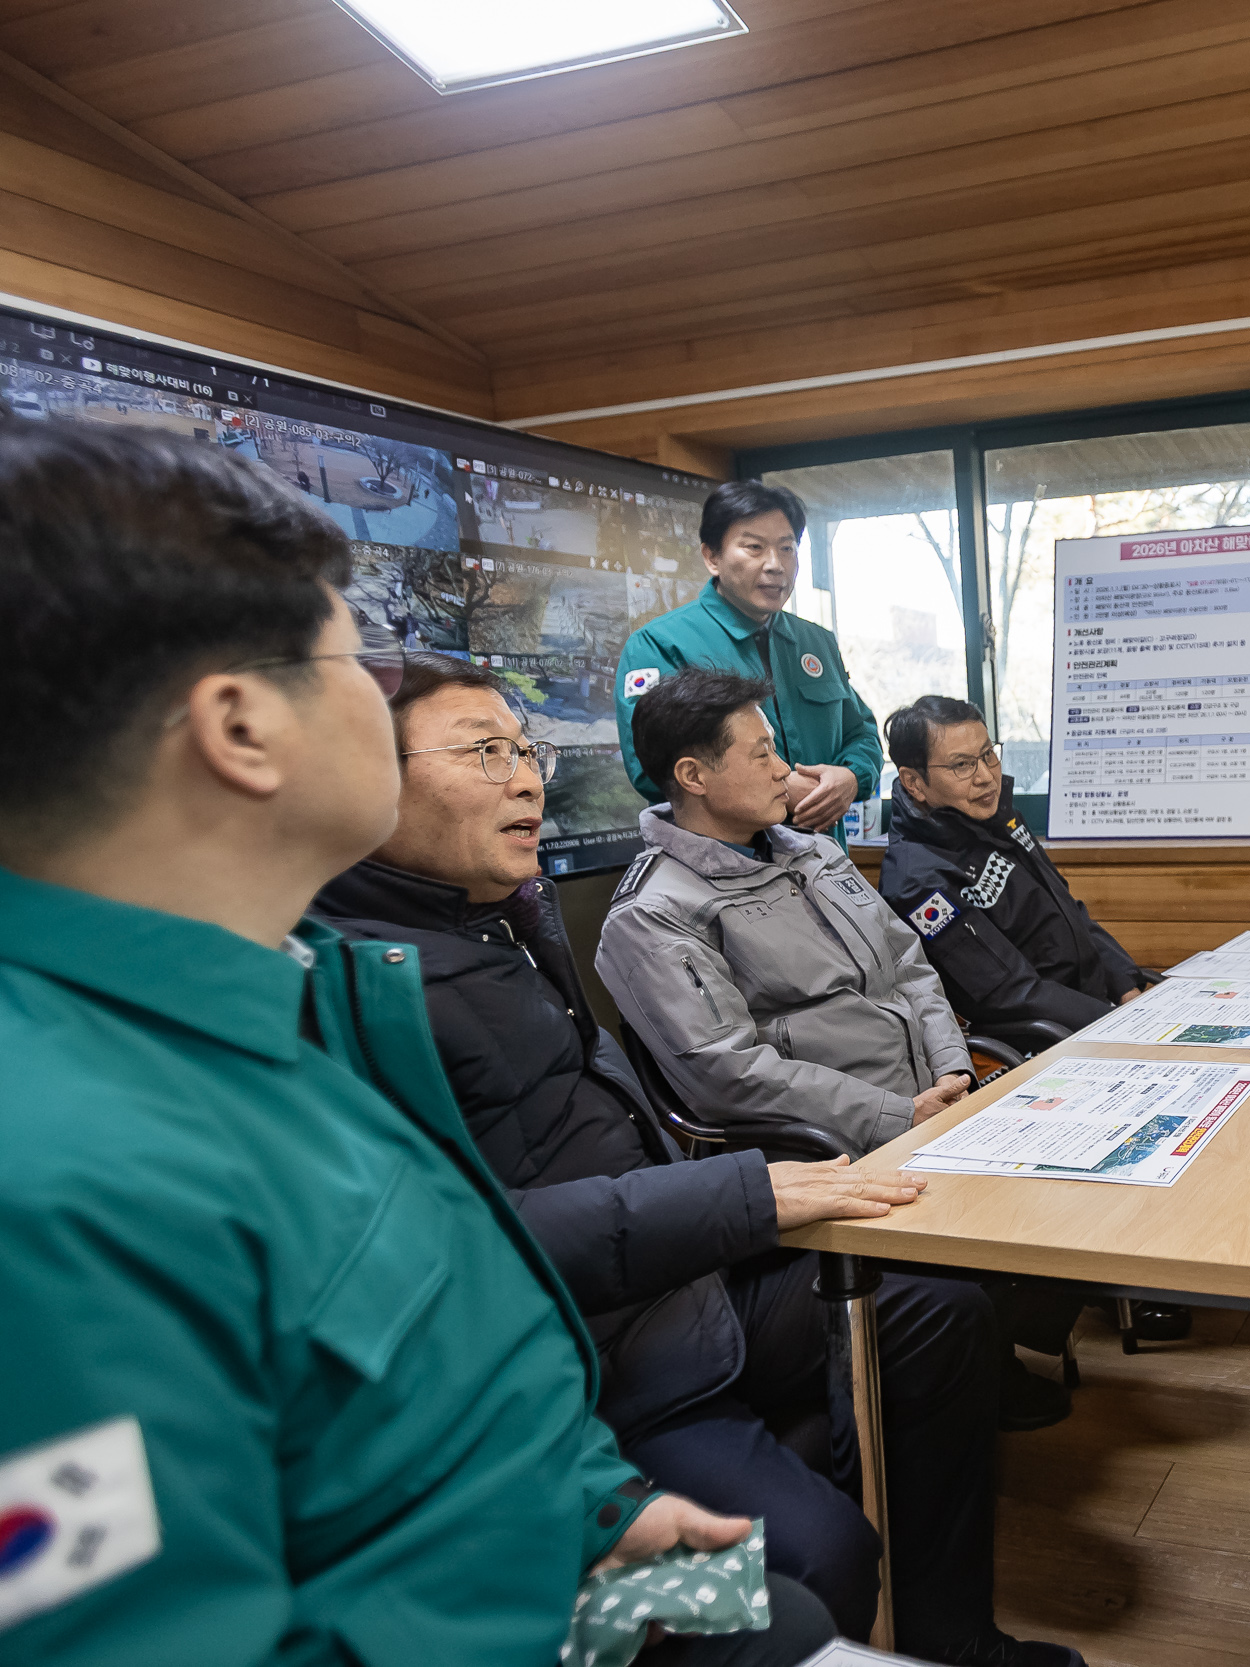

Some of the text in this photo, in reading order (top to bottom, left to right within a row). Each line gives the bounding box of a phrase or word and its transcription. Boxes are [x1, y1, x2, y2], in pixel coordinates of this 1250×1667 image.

[106, 363, 213, 397] 해맞이행사대비 (16)
[245, 415, 361, 447] [2] 공원-085-03-구의2
[1132, 542, 1177, 557] 2026년
[1180, 538, 1219, 554] 아차산
[1074, 628, 1104, 637] 개선사항
[1073, 660, 1118, 669] 안전관리계획
[929, 914, 955, 936] KOREA
